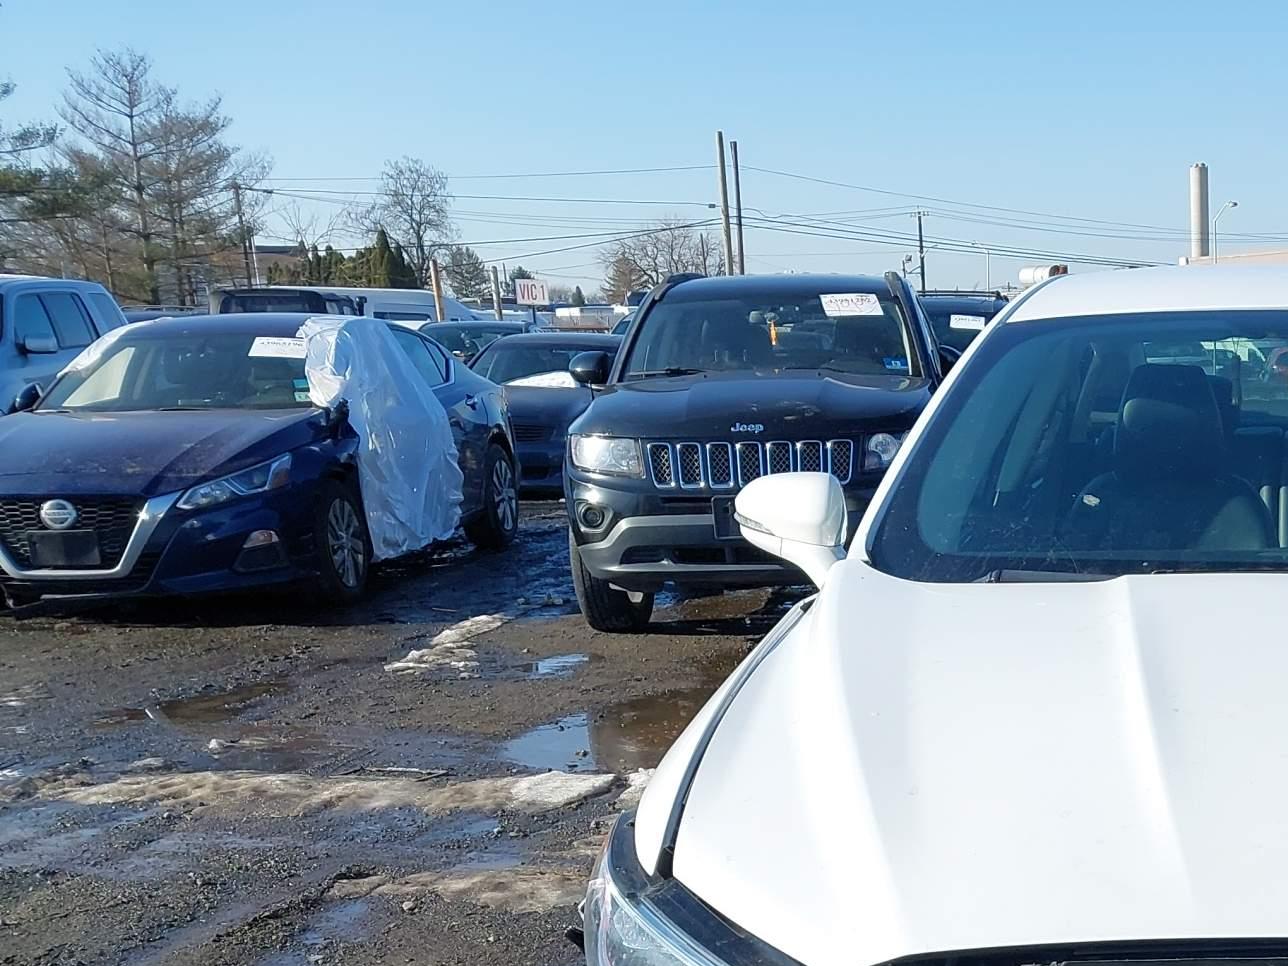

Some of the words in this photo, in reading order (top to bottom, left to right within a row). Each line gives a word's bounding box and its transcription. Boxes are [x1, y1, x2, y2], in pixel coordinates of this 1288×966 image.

[518, 283, 538, 301] VIC
[540, 284, 546, 301] 1
[731, 422, 764, 434] Jeep
